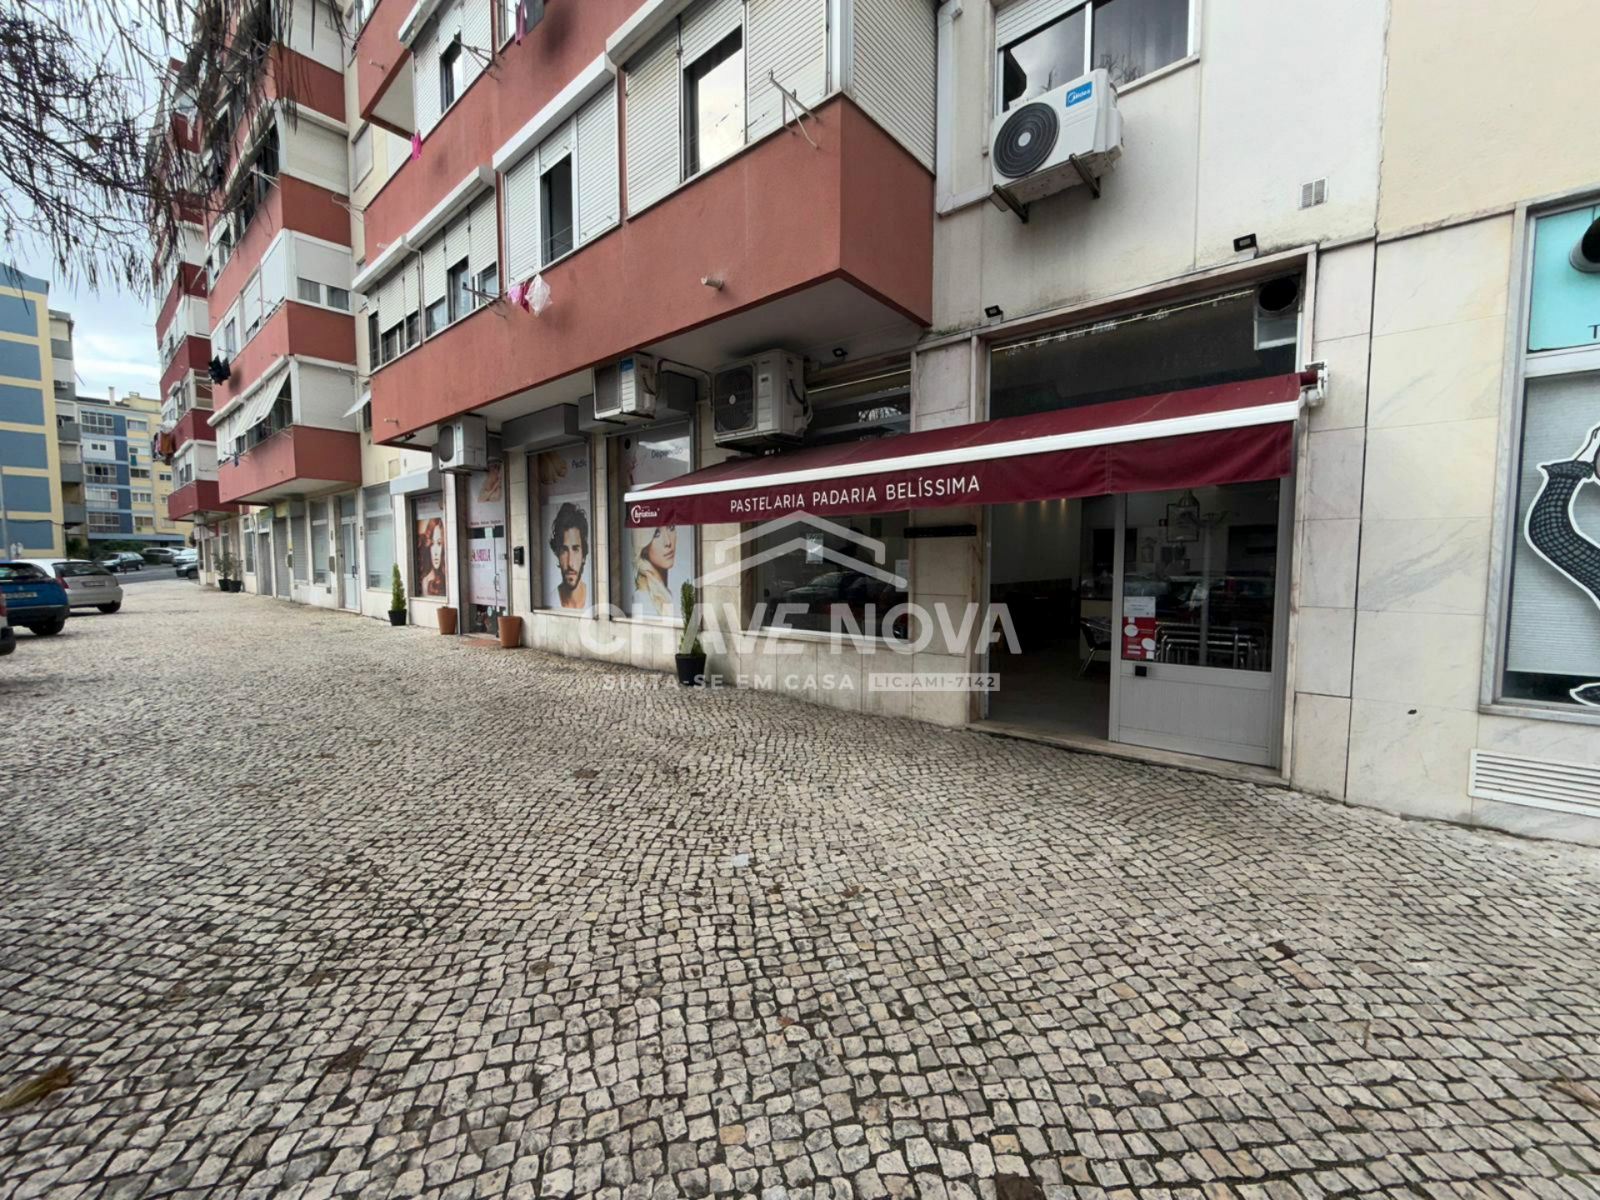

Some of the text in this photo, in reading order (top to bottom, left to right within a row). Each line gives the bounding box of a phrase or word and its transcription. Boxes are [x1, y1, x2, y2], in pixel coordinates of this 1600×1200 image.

[730, 475, 980, 512] PASTELARIA PADARIA BELÍSSIMA
